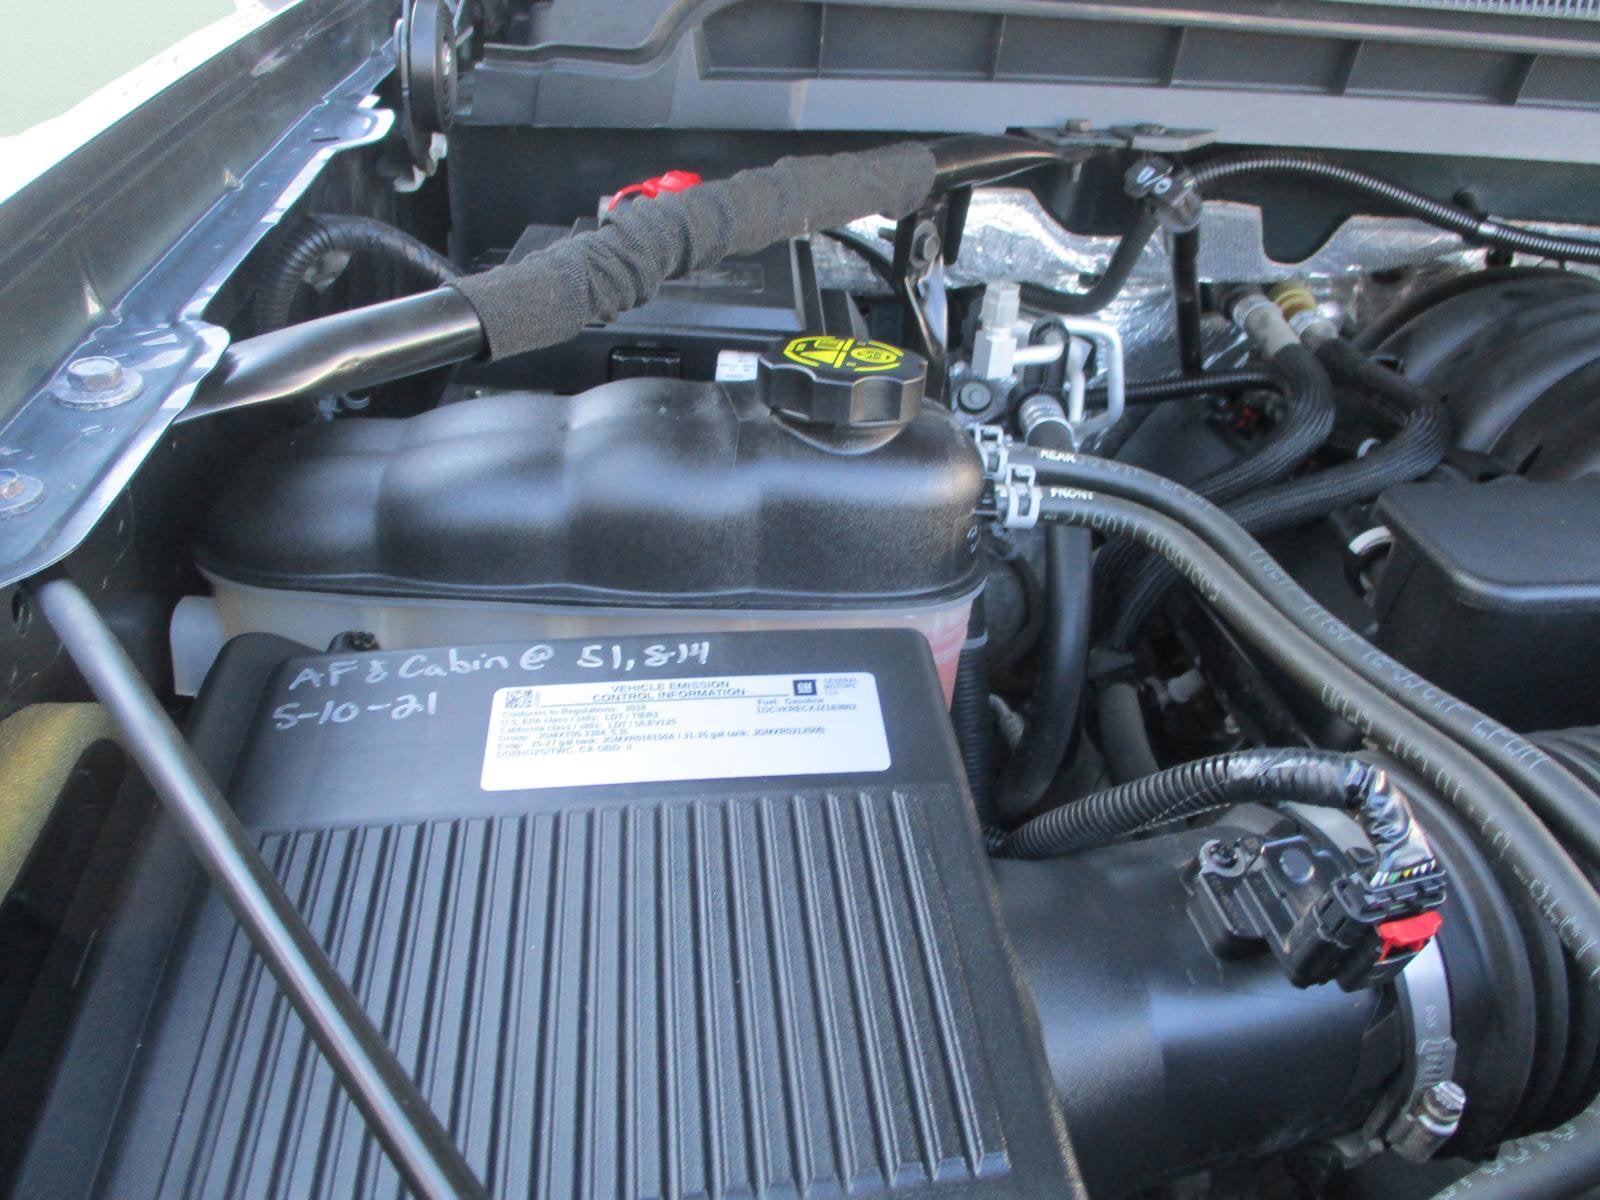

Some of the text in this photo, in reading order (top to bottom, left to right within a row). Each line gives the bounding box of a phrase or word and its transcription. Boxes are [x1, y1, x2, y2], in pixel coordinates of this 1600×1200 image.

[1041, 449, 1076, 464] REAR
[1050, 487, 1093, 500] FRONT
[399, 648, 509, 678] Cabin
[520, 644, 554, 671] @
[611, 680, 730, 693] VEHICLE EMISSION
[592, 687, 746, 701] CONTROL INFORMATION
[272, 692, 438, 730] 5-10-21
[502, 709, 547, 718] Conforms
[544, 716, 568, 724] class
[500, 725, 545, 734] California
[547, 723, 571, 731] class
[559, 738, 574, 747] gal
[710, 730, 725, 739] gal
